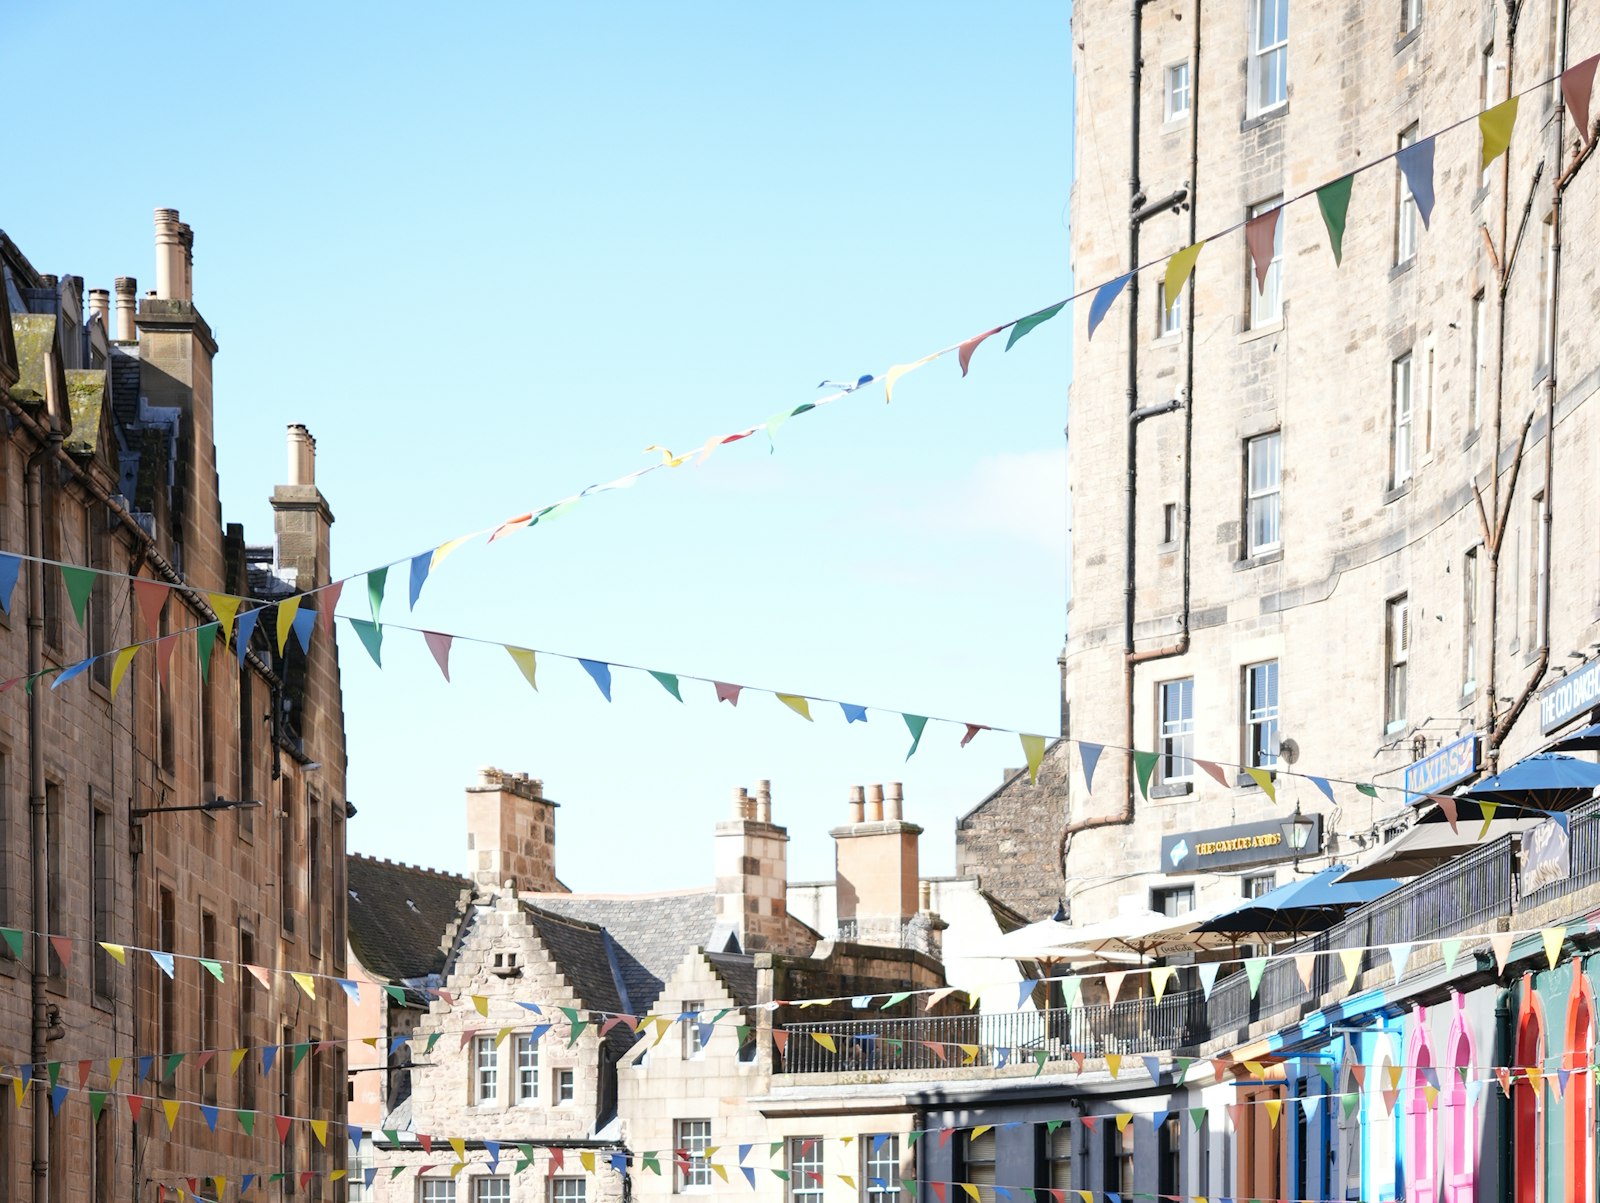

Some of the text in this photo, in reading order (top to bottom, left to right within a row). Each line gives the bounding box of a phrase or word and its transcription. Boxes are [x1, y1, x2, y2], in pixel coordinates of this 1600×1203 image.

[1542, 692, 1556, 727] THE
[1556, 682, 1573, 719] COO
[1408, 748, 1459, 796] MAXIES
[1195, 843, 1216, 855] THE
